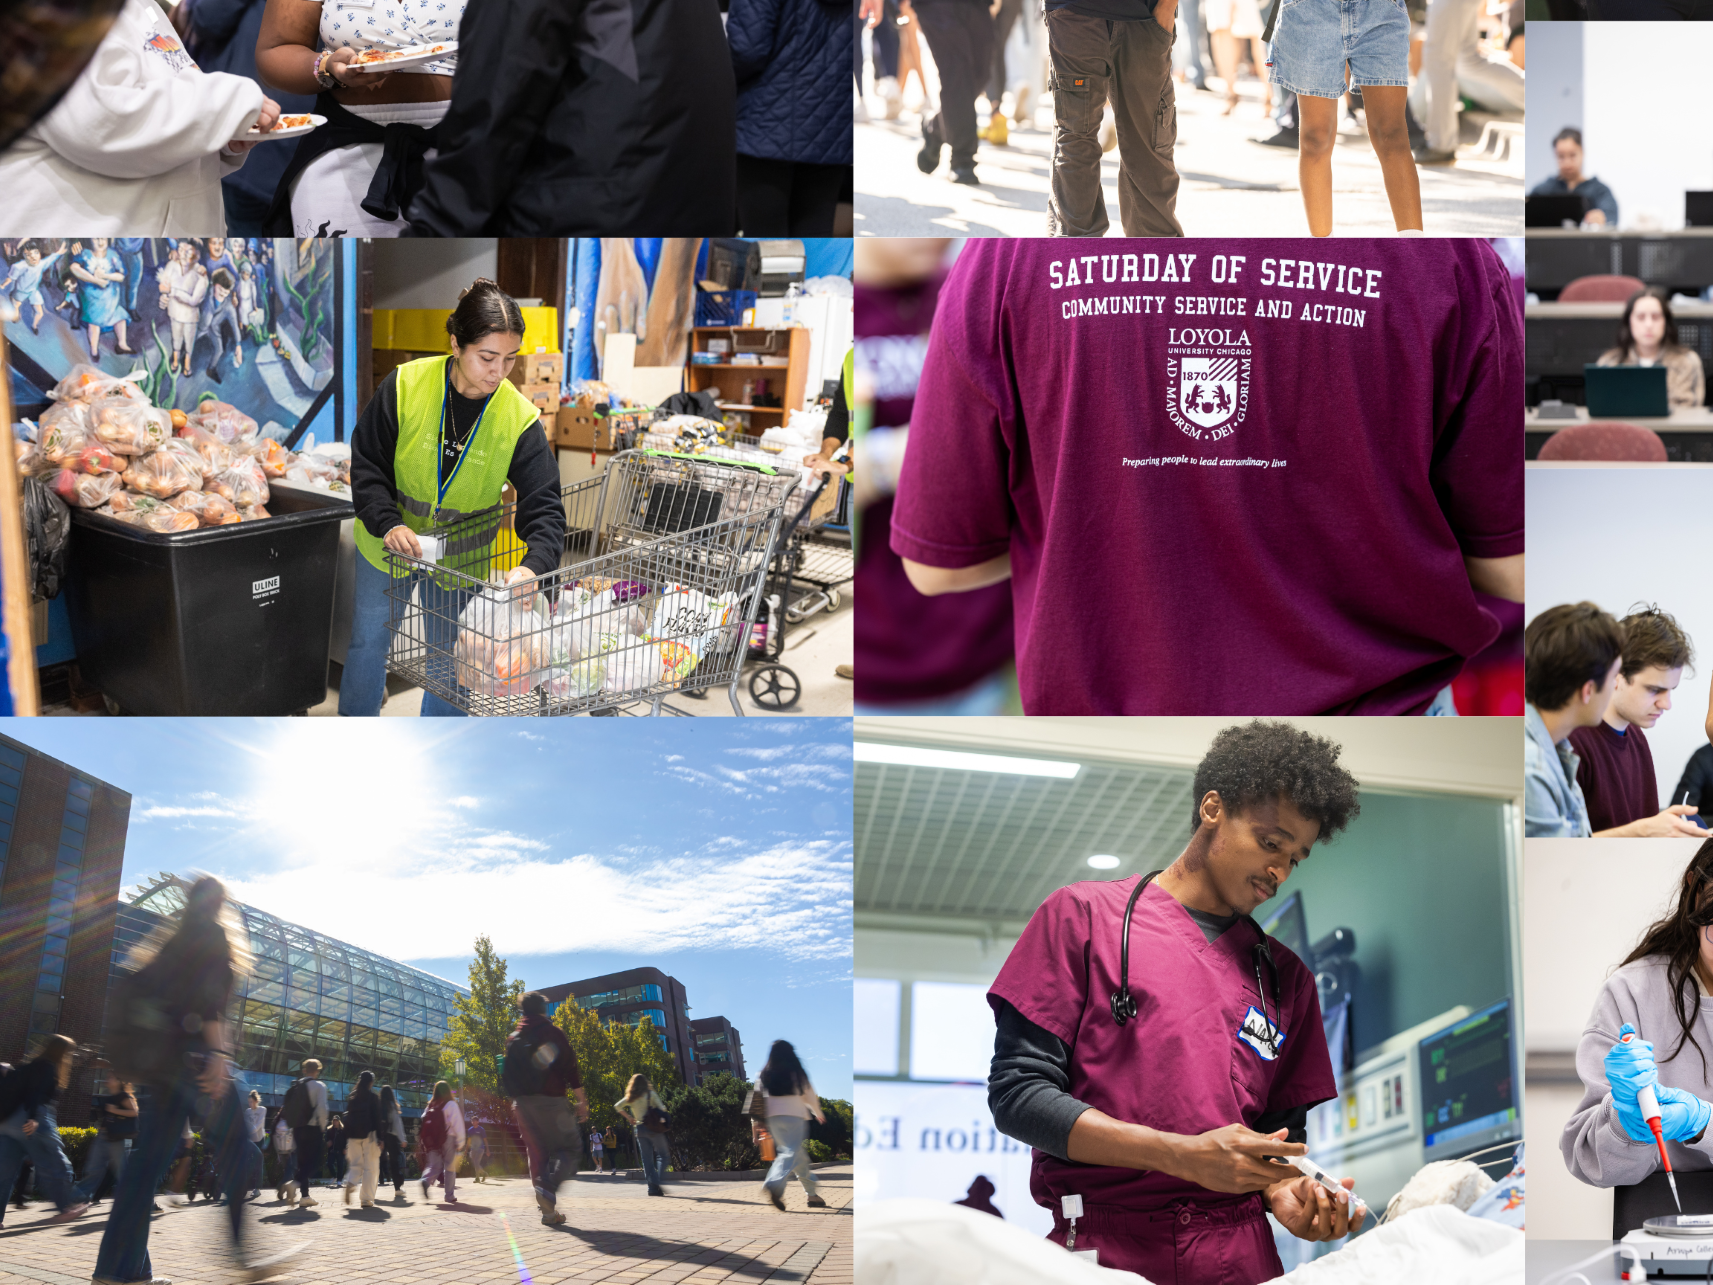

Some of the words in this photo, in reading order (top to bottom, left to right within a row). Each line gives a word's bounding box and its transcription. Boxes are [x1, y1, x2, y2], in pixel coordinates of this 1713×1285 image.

[1050, 254, 1197, 289] SATURDAY
[1211, 256, 1246, 283] OF
[1261, 259, 1382, 298] SERVICE
[1062, 296, 1166, 319] COMMUNITY
[1174, 297, 1247, 315] SERVICE
[1255, 299, 1292, 319] AND
[1301, 304, 1366, 327] ACTION
[1168, 328, 1252, 346] LOYOLA
[1167, 357, 1177, 377] AD
[1183, 372, 1208, 381] 1870
[1237, 358, 1251, 422] GLORIAM
[1166, 387, 1202, 440] MAJOREM
[1211, 423, 1234, 441] DEI
[1123, 457, 1159, 468] Preparing
[1161, 455, 1188, 465] people
[1199, 457, 1218, 465] lead
[1220, 457, 1269, 468] extraordinary
[1271, 459, 1287, 467] lives
[254, 578, 278, 591] ULINE
